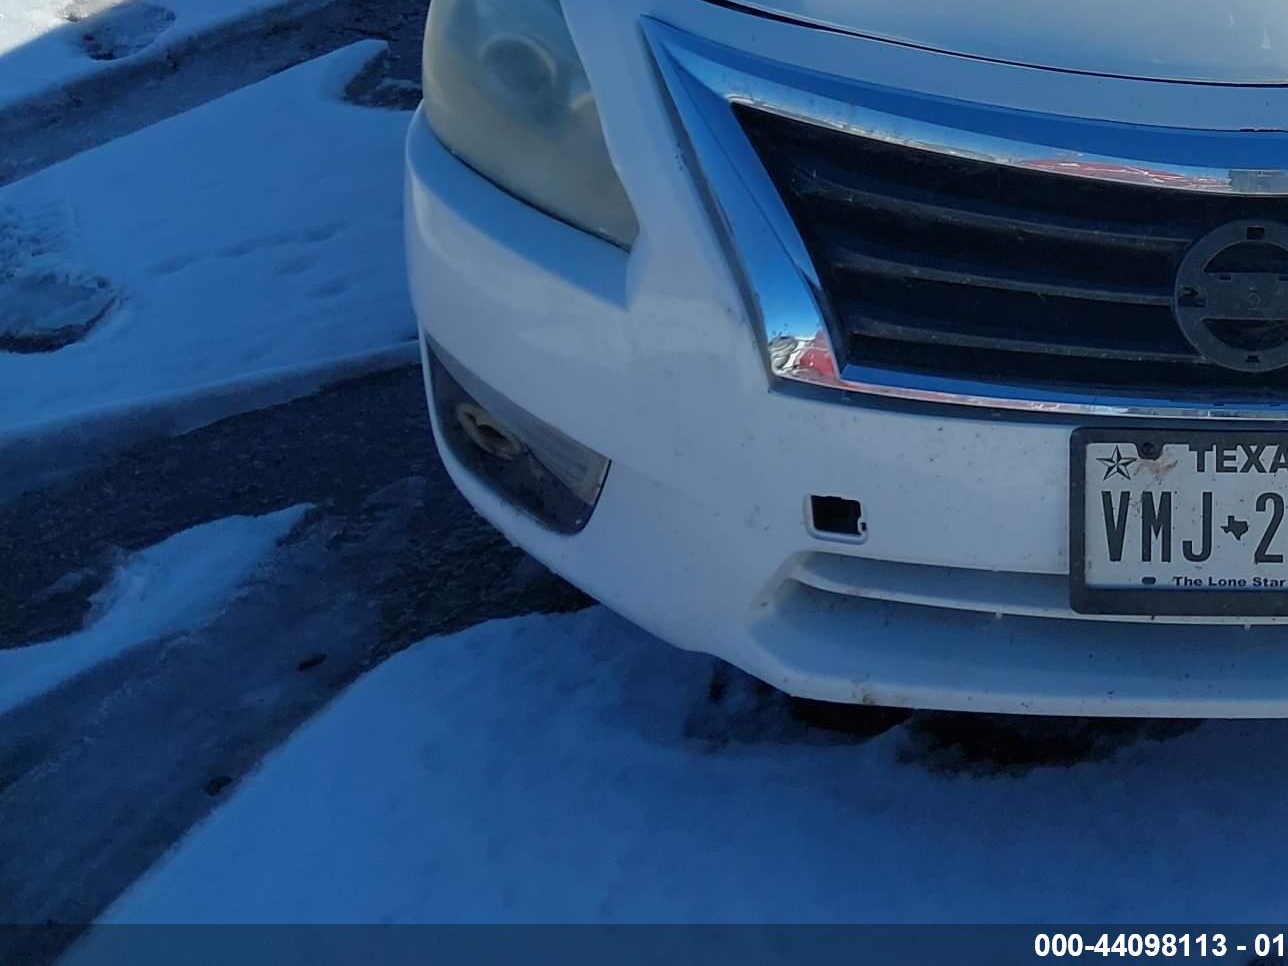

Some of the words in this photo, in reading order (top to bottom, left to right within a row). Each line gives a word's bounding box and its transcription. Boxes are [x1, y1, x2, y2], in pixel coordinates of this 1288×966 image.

[1101, 490, 1213, 564] VMJ
[1172, 576, 1203, 587] The
[1208, 576, 1247, 587] Lone
[1252, 576, 1286, 588] Star
